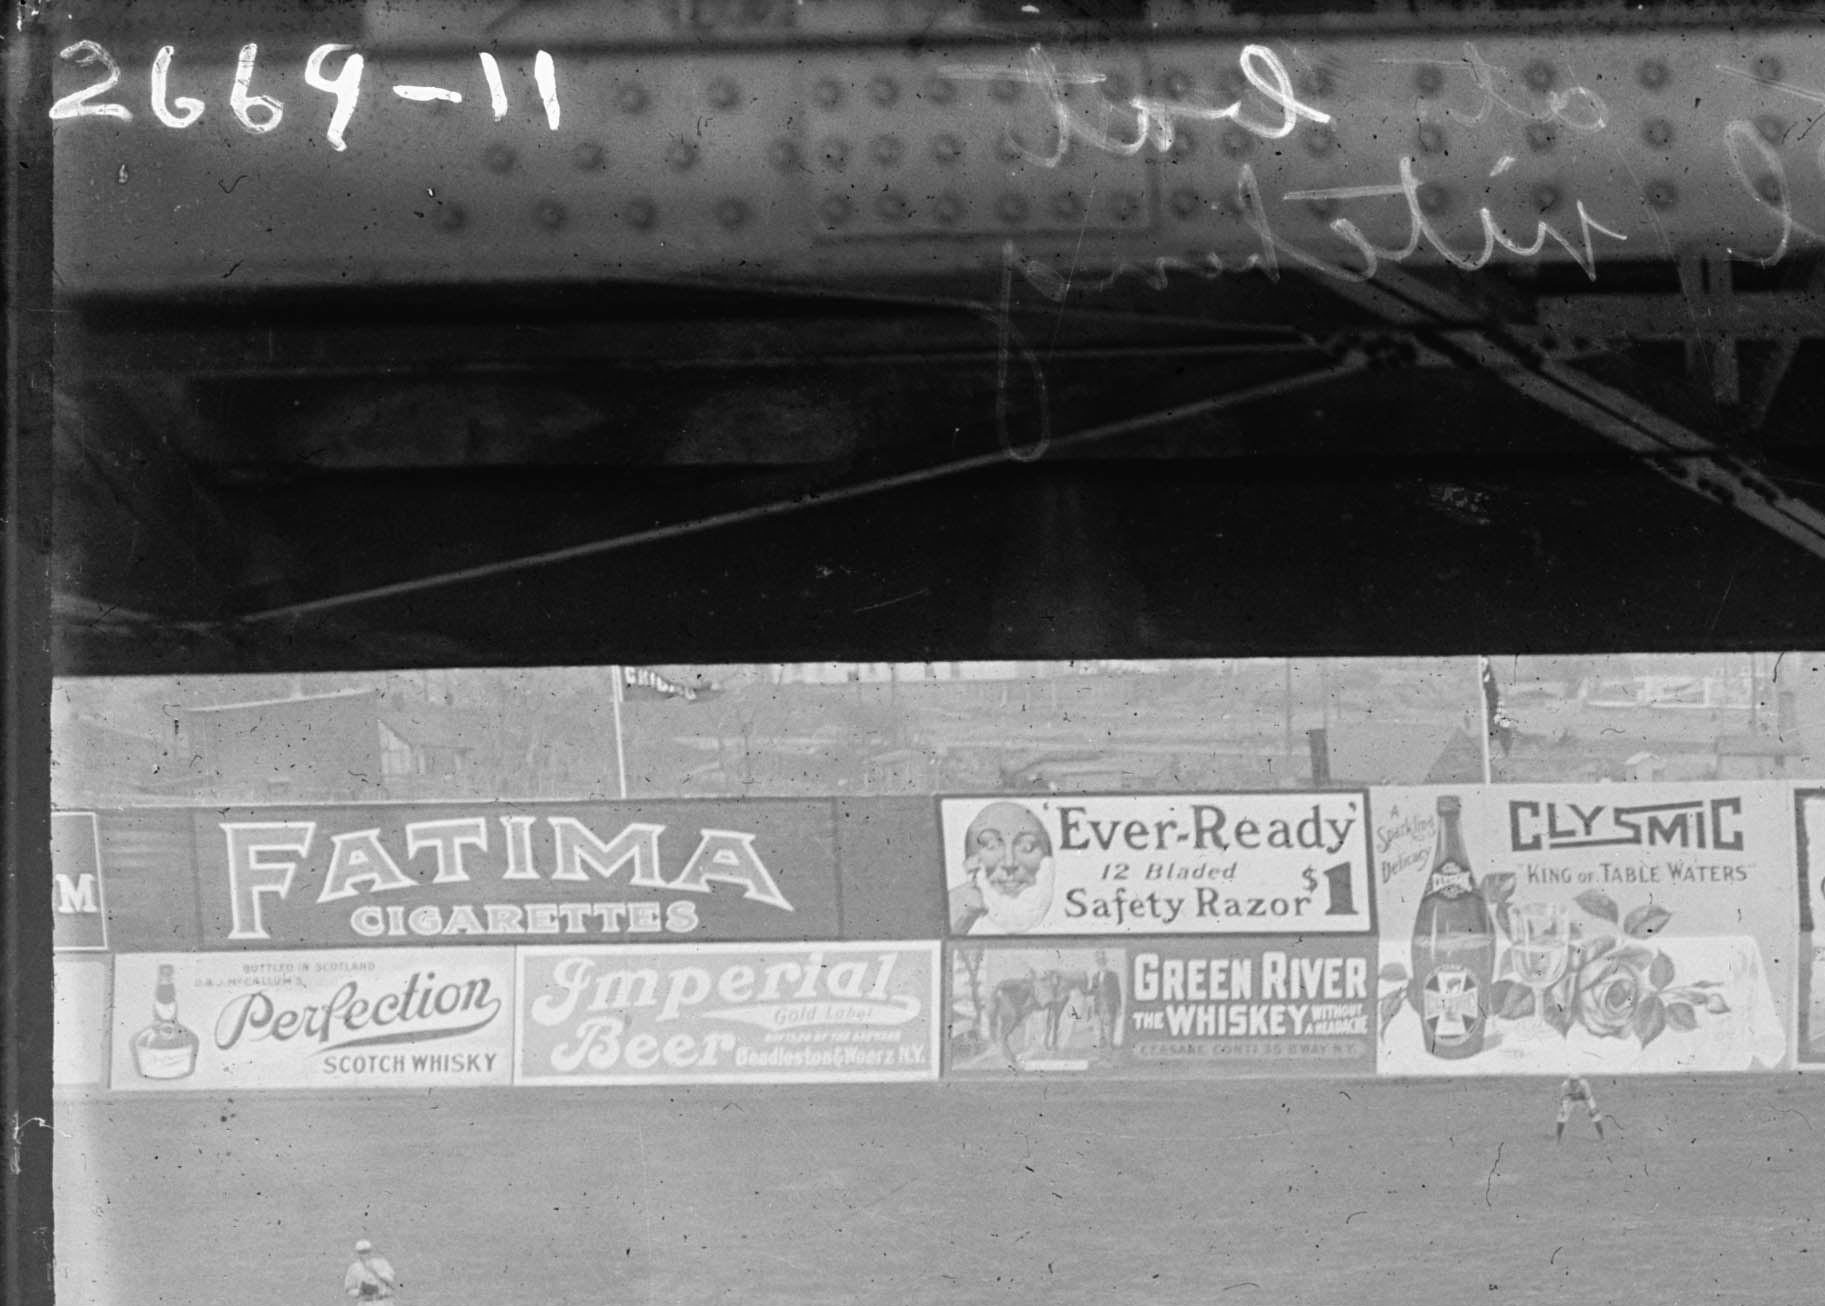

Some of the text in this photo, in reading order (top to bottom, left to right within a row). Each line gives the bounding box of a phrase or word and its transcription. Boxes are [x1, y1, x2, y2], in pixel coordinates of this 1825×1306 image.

[1508, 797, 1745, 851] CLYSMIC
[217, 815, 795, 940] FATIMA
[1100, 861, 1240, 882] 12 Bladed
[1600, 861, 1661, 884] TABLE
[350, 900, 700, 938] CIGARETTES
[1064, 886, 1314, 926] Safety Razor
[531, 951, 900, 1027] Imperial
[1133, 951, 1368, 1002] GREEN RIVER
[214, 970, 502, 1052] Perfection
[1133, 1011, 1165, 1031] THE
[1165, 1003, 1309, 1037] WHISKEY
[323, 1053, 497, 1074] SCOTCH WHISKY
[550, 1014, 736, 1073] Beer
